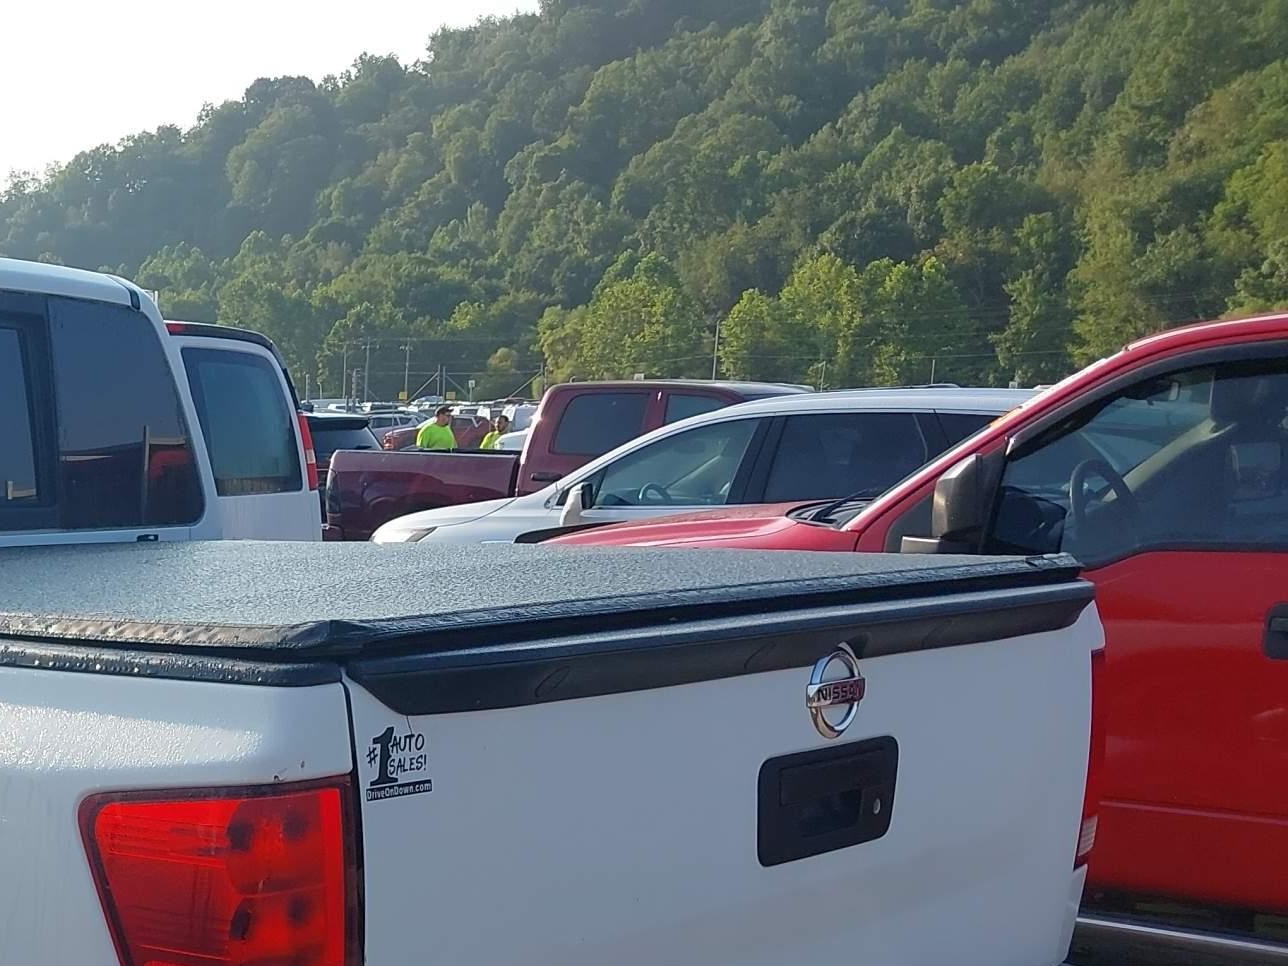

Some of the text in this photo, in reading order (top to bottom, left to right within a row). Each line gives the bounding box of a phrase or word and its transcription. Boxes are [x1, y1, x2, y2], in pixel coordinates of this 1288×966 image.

[390, 733, 425, 754] AUTO
[388, 754, 427, 776] SALES!
[366, 782, 432, 800] DriveOnDown.com
